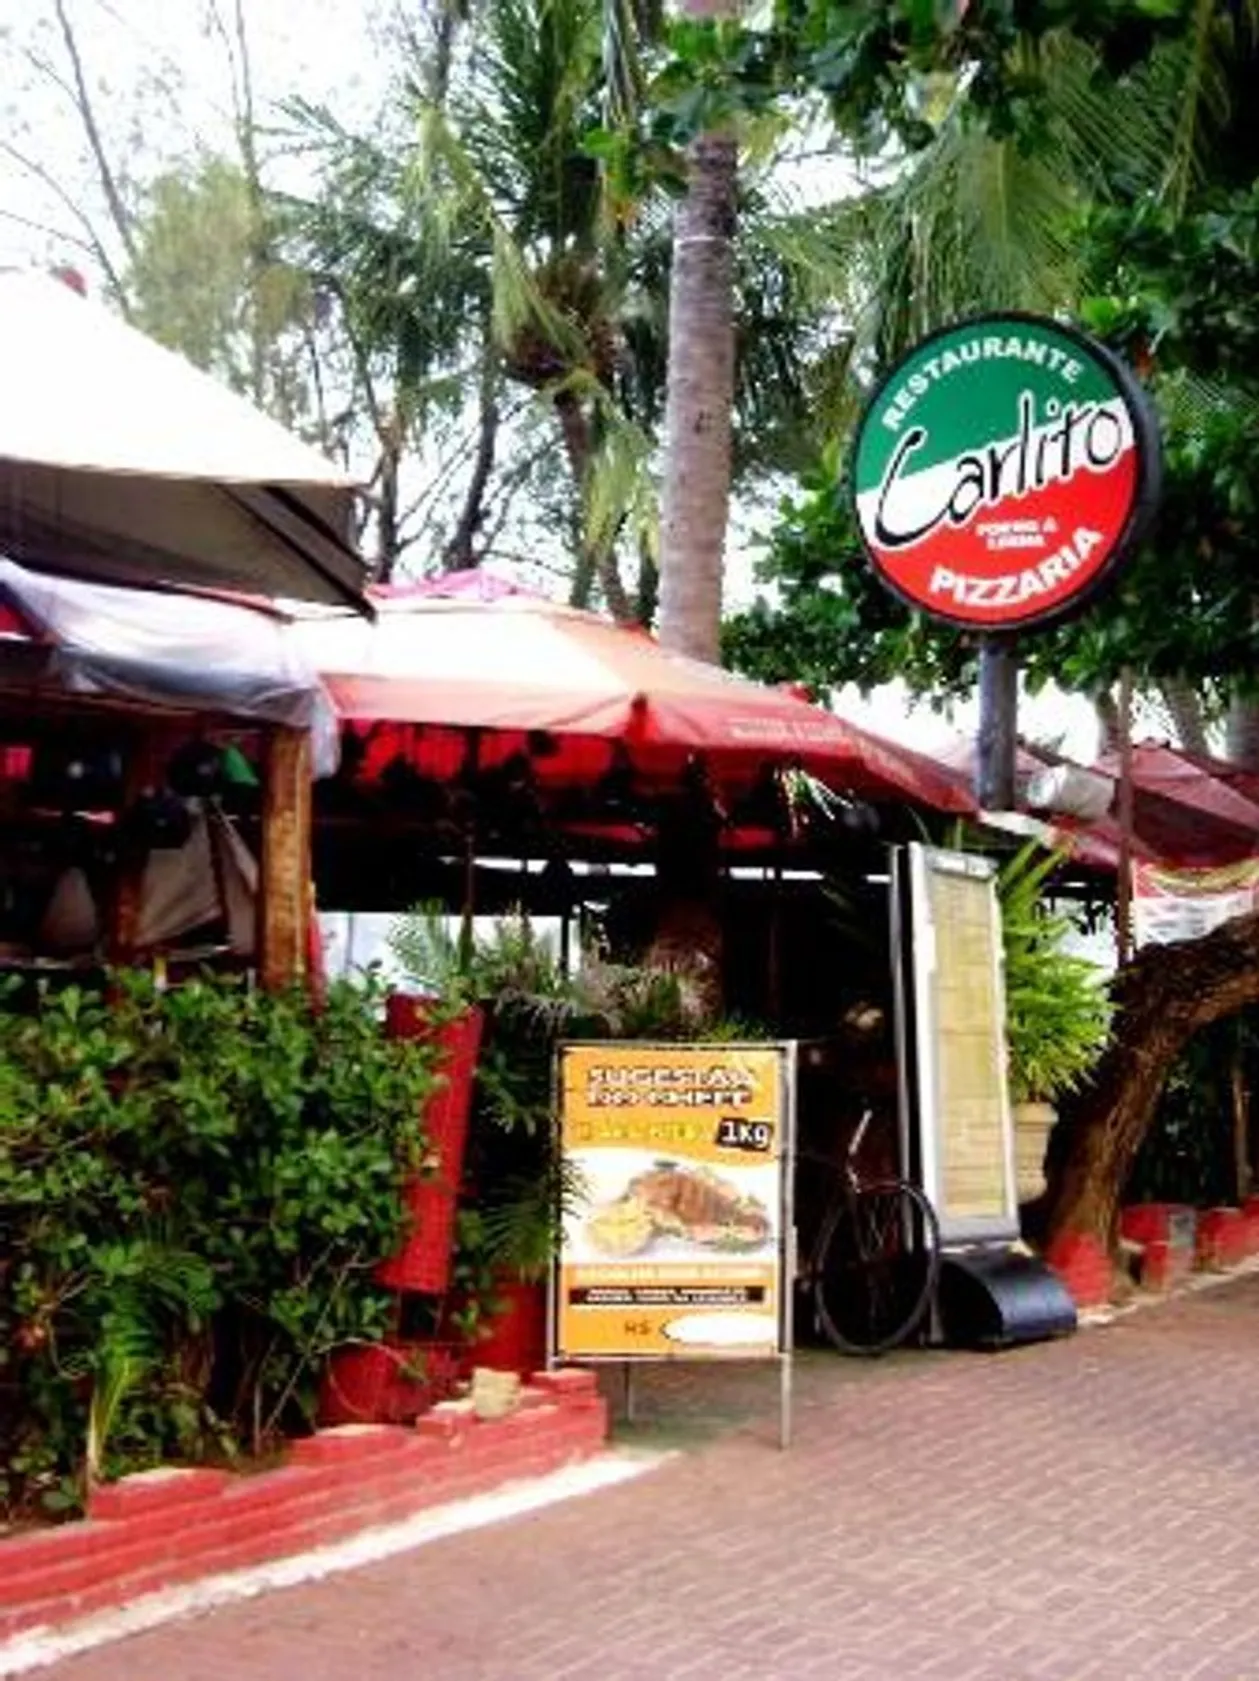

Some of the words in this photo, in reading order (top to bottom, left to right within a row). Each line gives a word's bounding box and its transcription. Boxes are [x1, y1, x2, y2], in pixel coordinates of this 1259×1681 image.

[882, 336, 1084, 432] RESTAURANTE
[875, 390, 1122, 546] Carlito
[929, 526, 1104, 606] PIZZARIA
